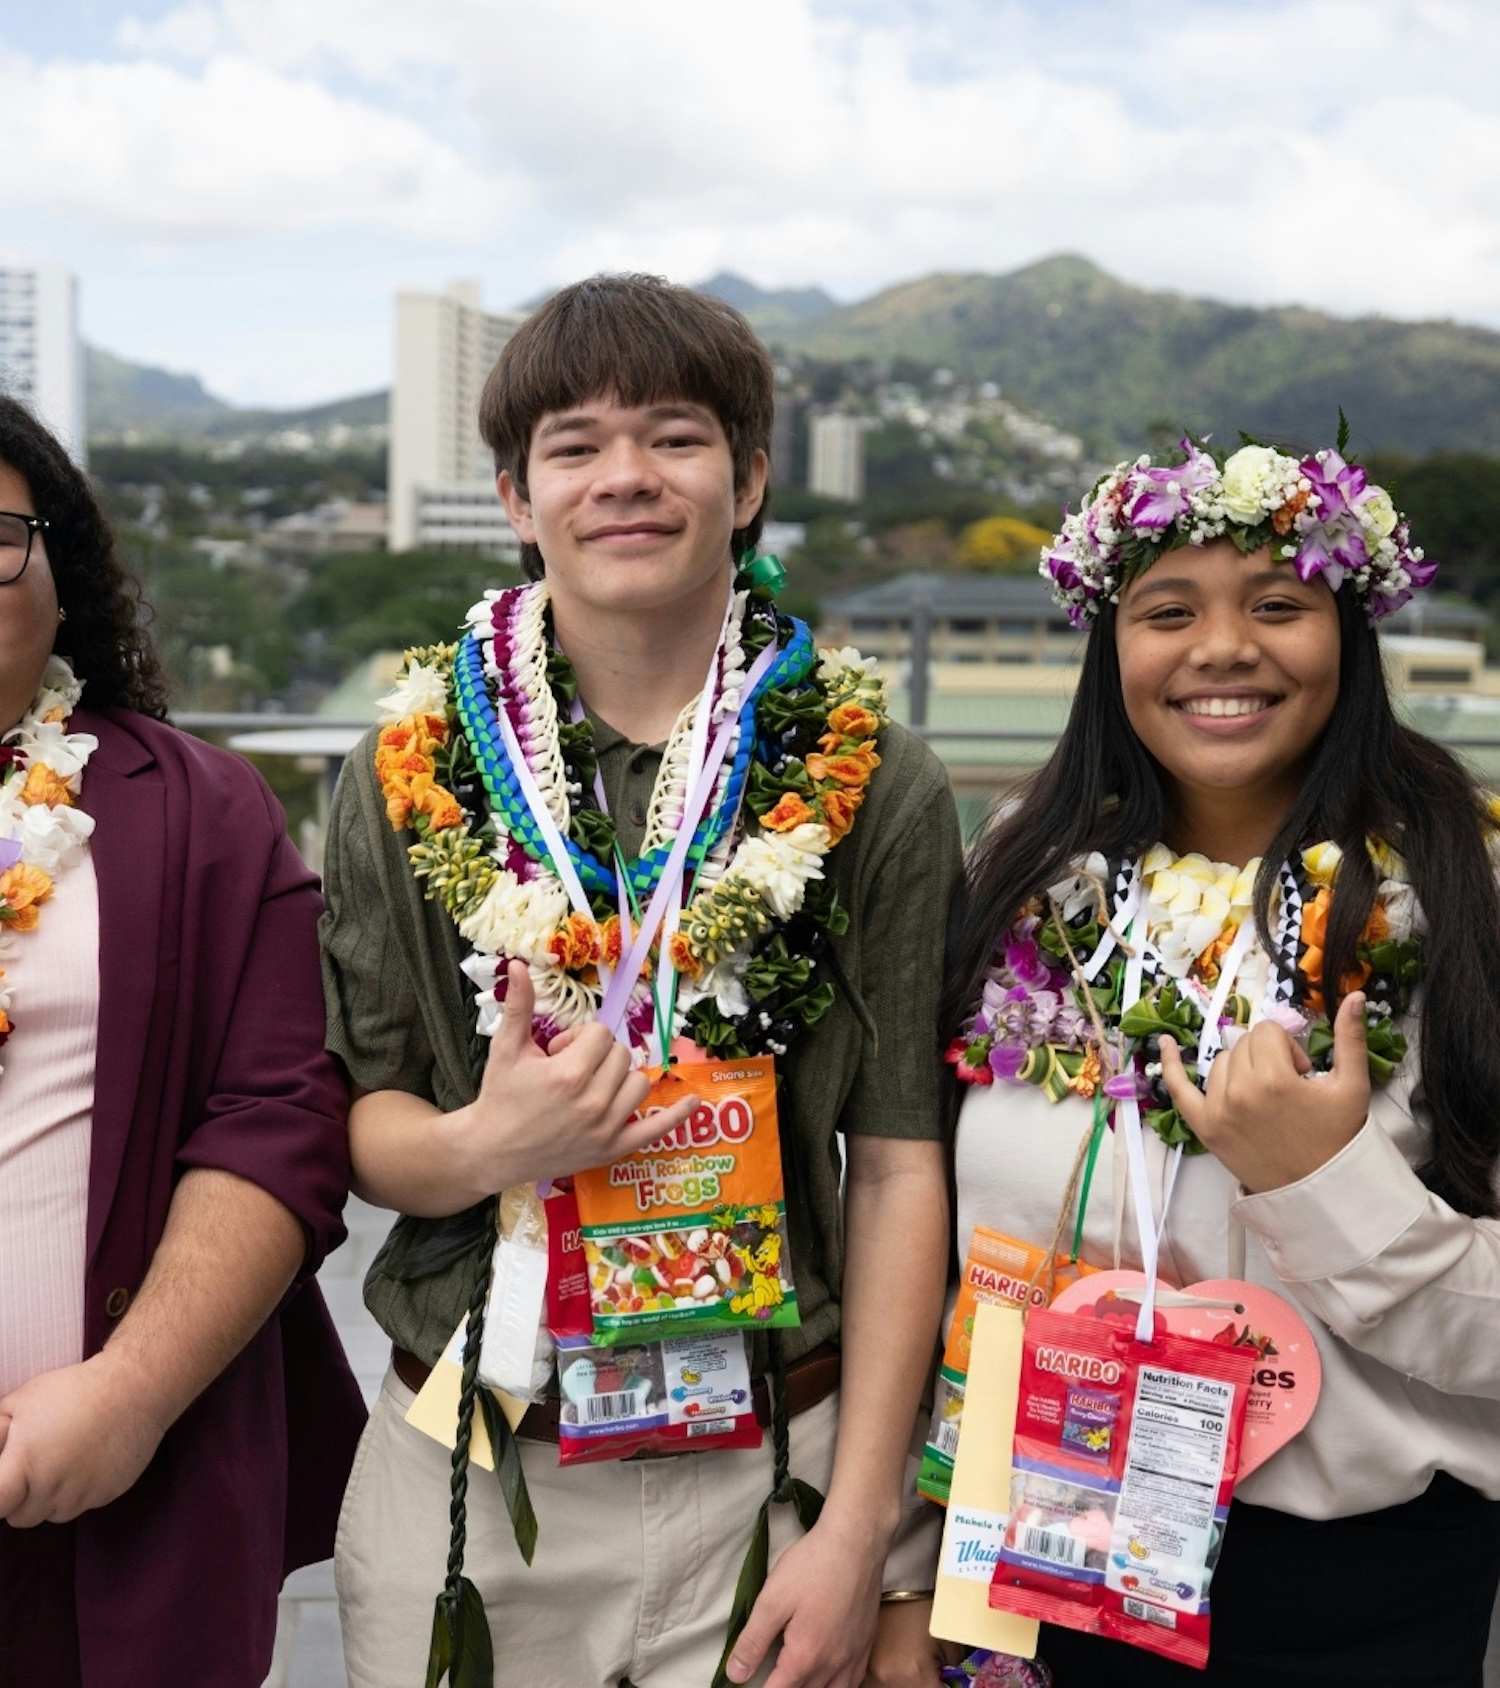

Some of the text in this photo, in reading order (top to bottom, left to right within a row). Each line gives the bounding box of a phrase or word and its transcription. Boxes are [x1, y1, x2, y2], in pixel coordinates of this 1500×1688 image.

[711, 1070, 745, 1083] Share
[611, 1154, 734, 1186] Mini Rainbow
[638, 1176, 719, 1210] Frogs
[969, 1264, 1045, 1305] HARIBO
[1035, 1346, 1120, 1385] HARIBO
[1142, 1370, 1229, 1396] Nutrition Facts
[1248, 1398, 1272, 1410] erry
[1136, 1407, 1179, 1422] Calories
[1199, 1419, 1222, 1431] 100
